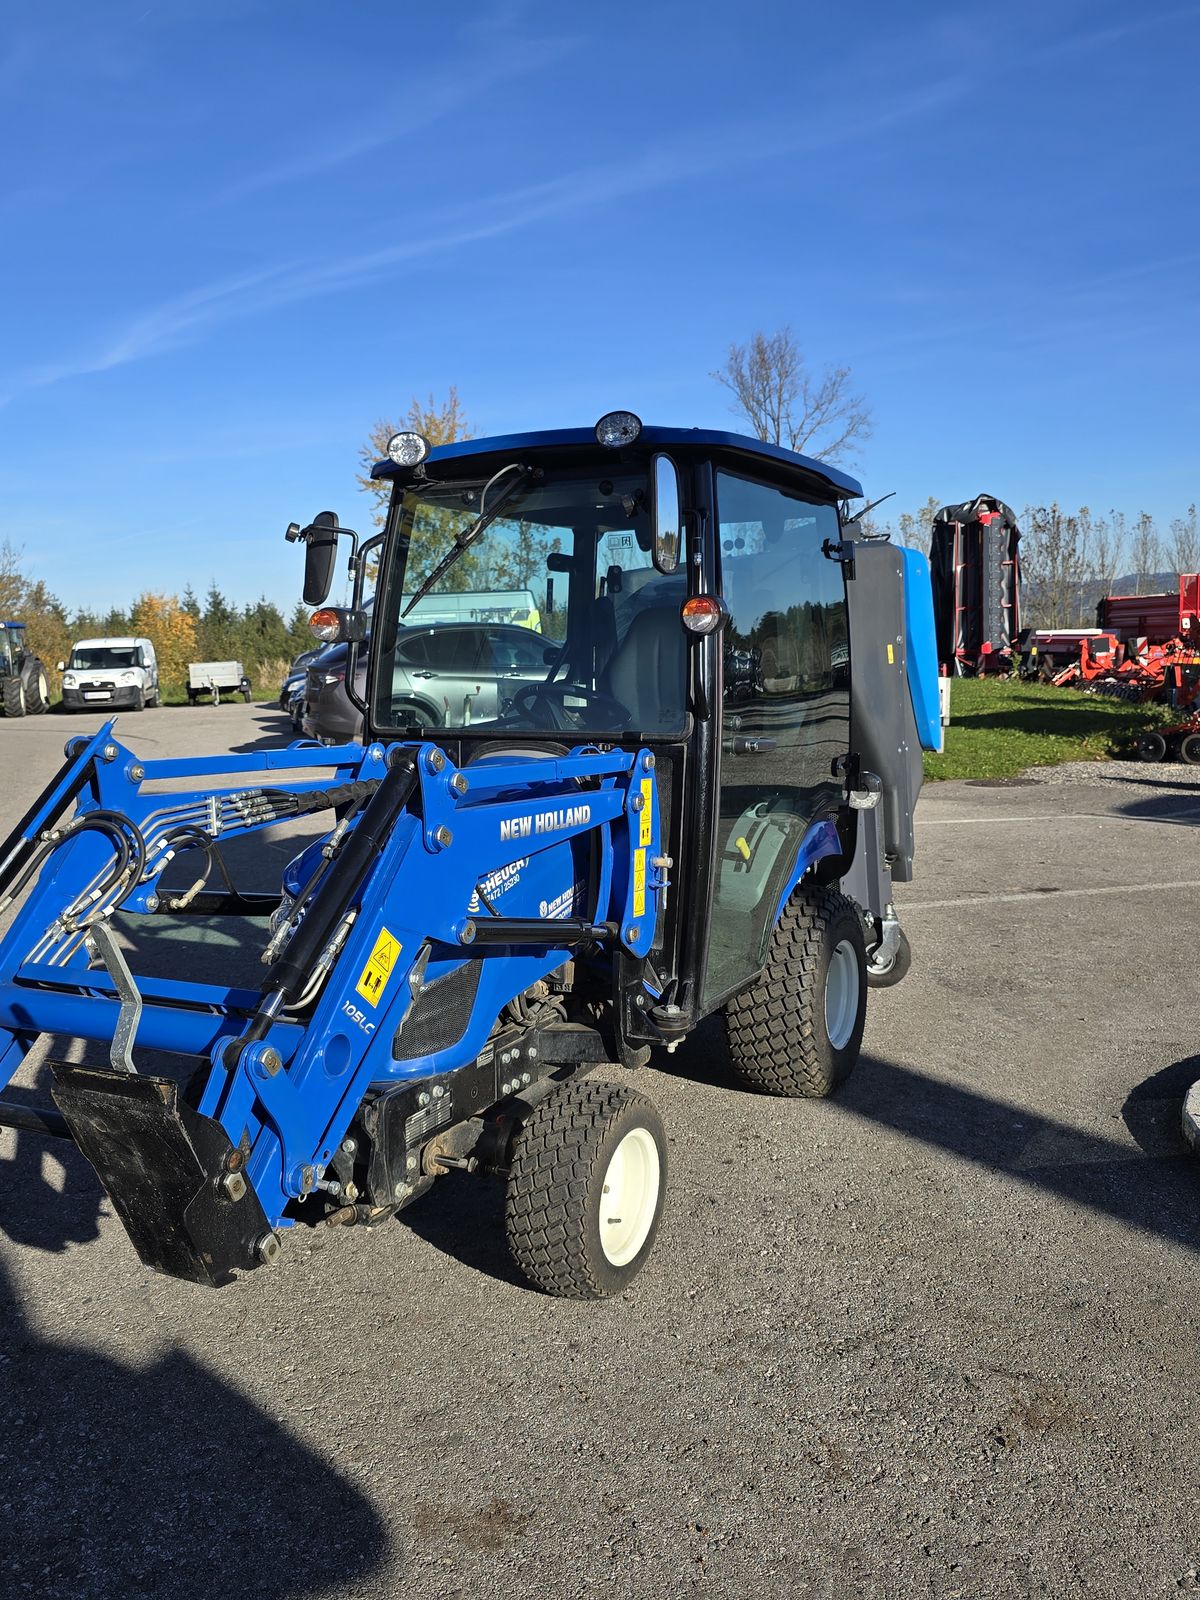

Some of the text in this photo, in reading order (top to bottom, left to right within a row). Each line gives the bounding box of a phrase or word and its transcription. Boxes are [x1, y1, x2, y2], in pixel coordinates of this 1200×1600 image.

[501, 805, 591, 841] NEW HOLLAND
[548, 895, 562, 914] NEW
[341, 1000, 376, 1034] 105LC
